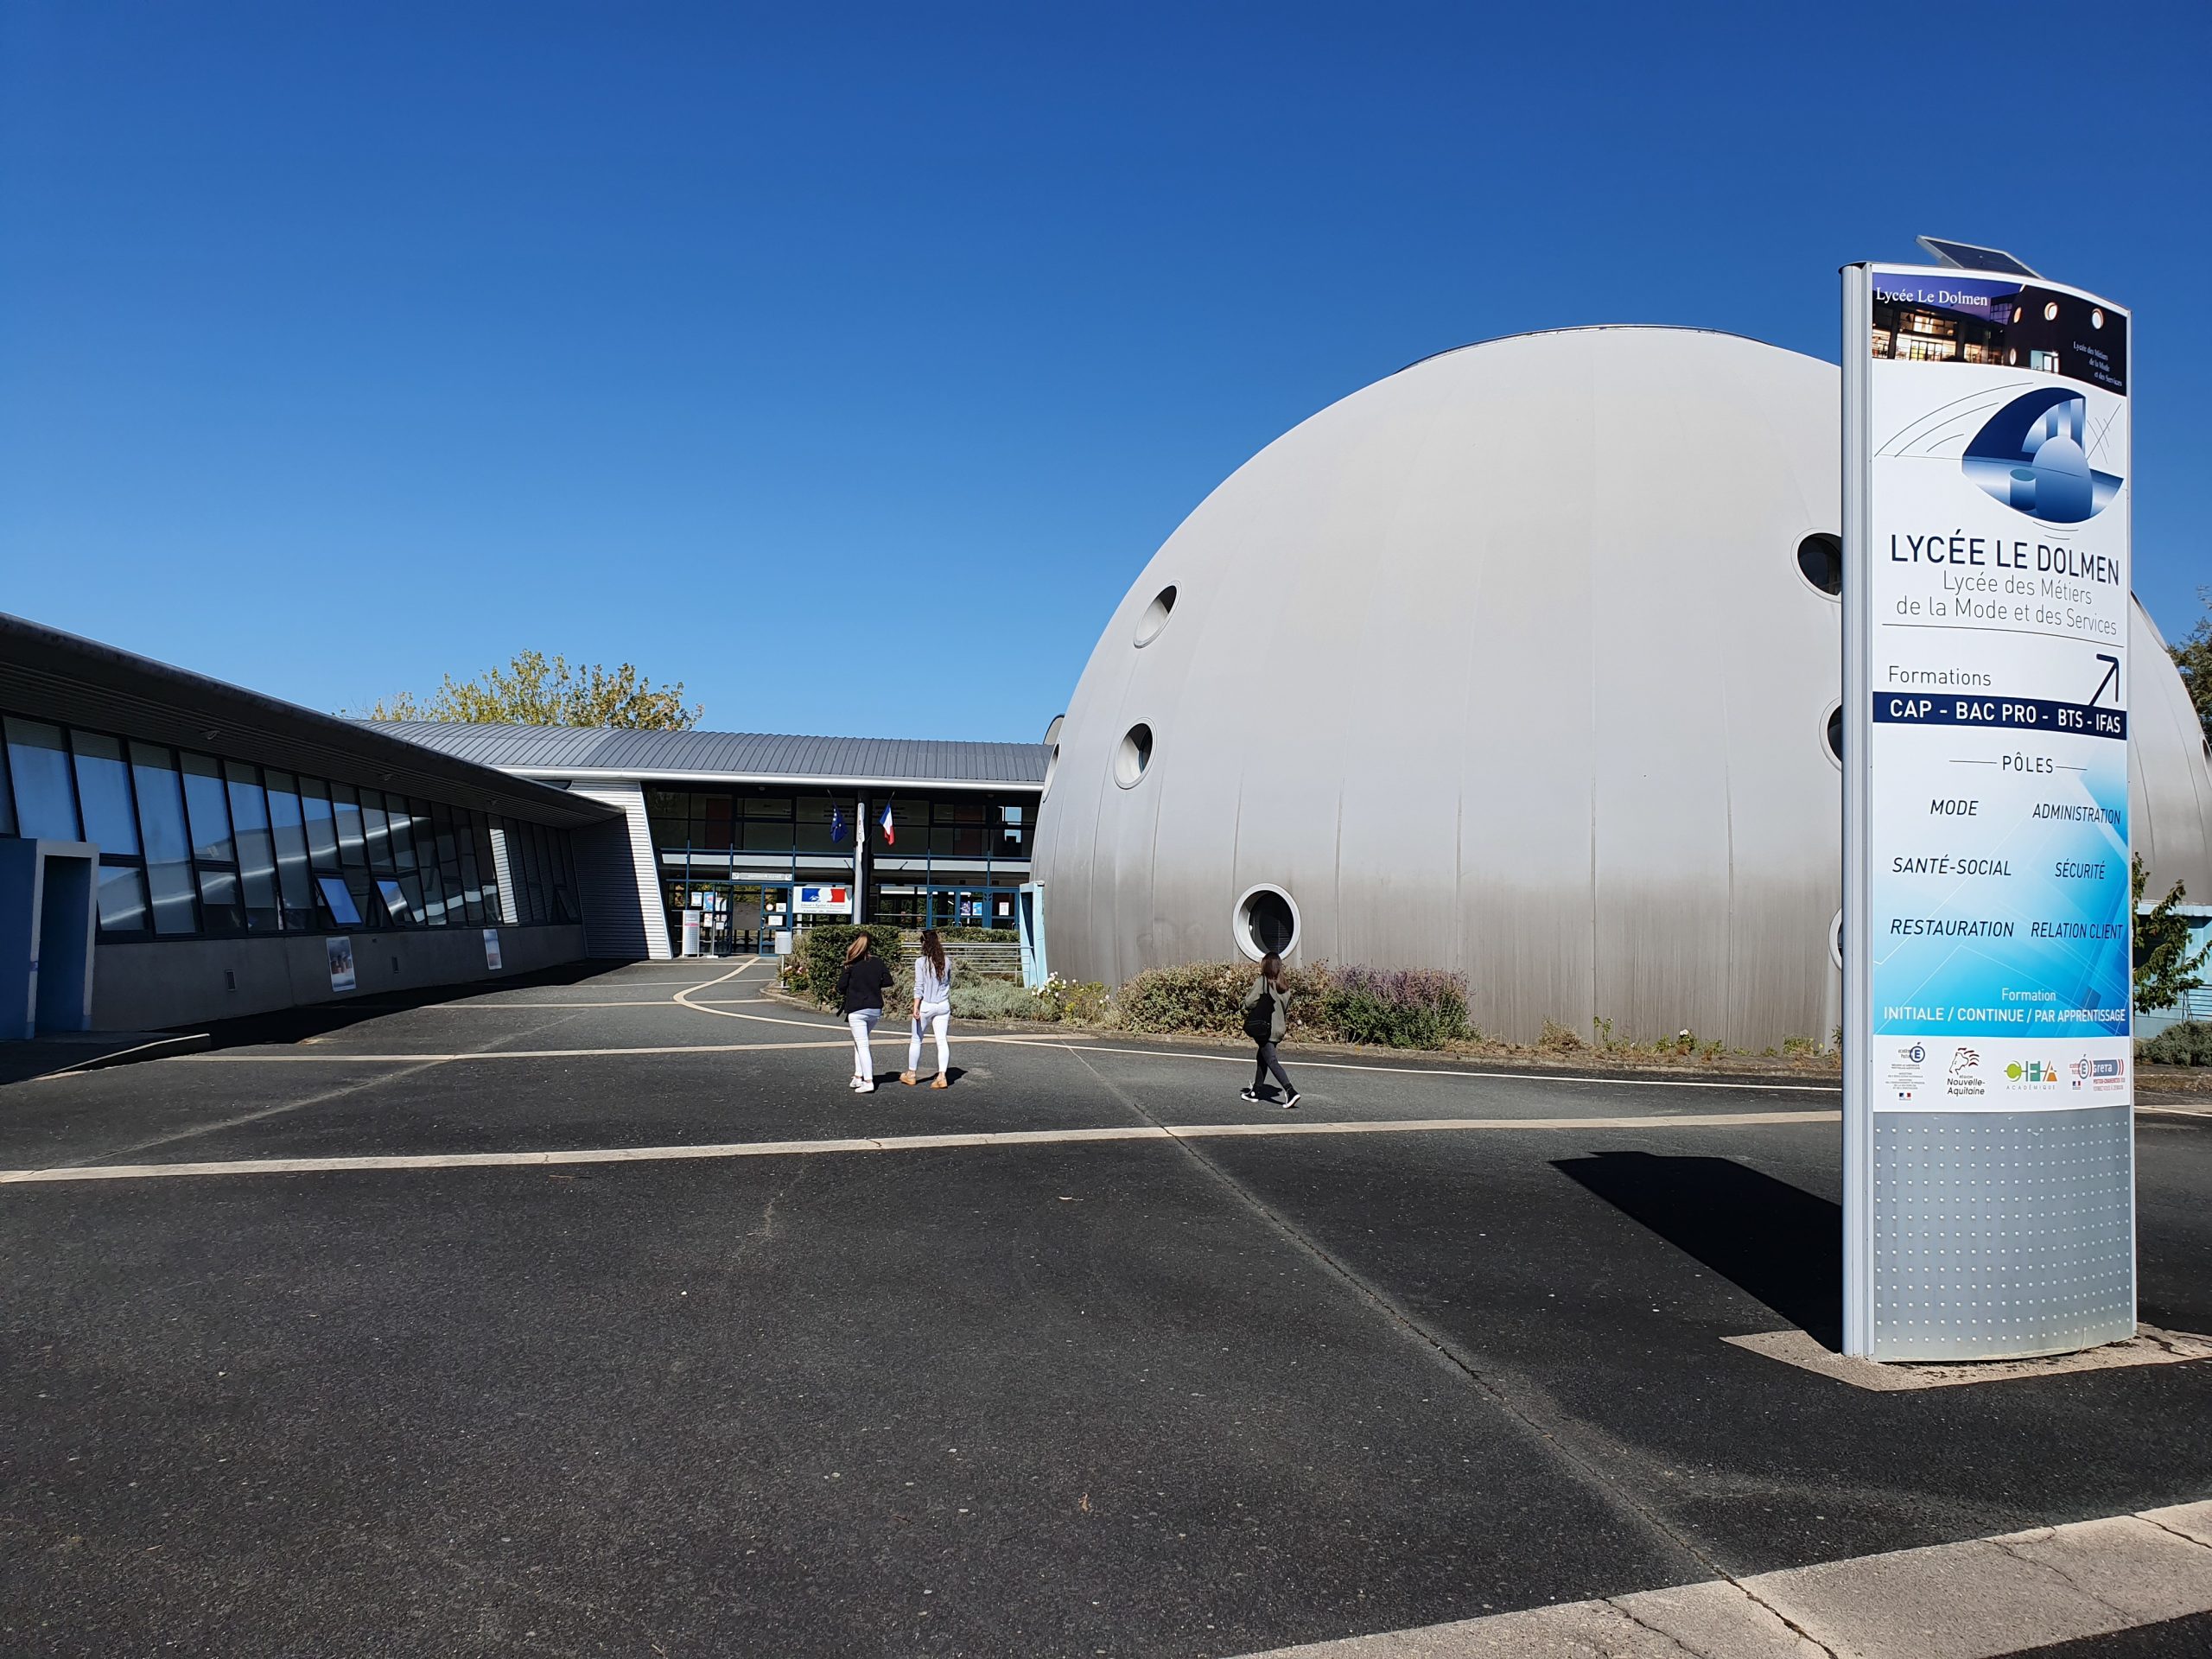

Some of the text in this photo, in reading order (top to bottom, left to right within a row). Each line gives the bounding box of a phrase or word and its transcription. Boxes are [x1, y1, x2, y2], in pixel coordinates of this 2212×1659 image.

[1876, 287, 1987, 306] Lycée Le Dolmen
[1891, 529, 2120, 586] LYCÉE LE DOLMEN
[1943, 570, 2093, 605] Lycée des Métiers
[1897, 595, 2117, 636] de la Mode et des Services
[1889, 665, 1992, 686] Formations
[1890, 699, 1932, 718] CAP
[1955, 702, 1995, 721] BAC
[2002, 705, 2037, 723] PRO
[2057, 709, 2083, 728] BTS
[2095, 713, 2120, 734] IFAS
[2002, 752, 2053, 773] PÔLES
[1929, 799, 1979, 816] MODE
[2032, 803, 2121, 825] ADMINISTRATION
[1892, 854, 2012, 876] SANTÉ-SOCIAL
[2055, 858, 2106, 880] SÉCURITÉ
[1891, 918, 2014, 938] RESTAURATION
[2031, 922, 2123, 940] RELATION CLIENT
[2001, 988, 2056, 1002] Formation
[1884, 1006, 2126, 1024] INITIALE / CONTINUE / PAR APPRENTISSAGE
[1947, 1078, 1986, 1086] Nouvelle-
[1947, 1086, 1985, 1097] Aquitaine
